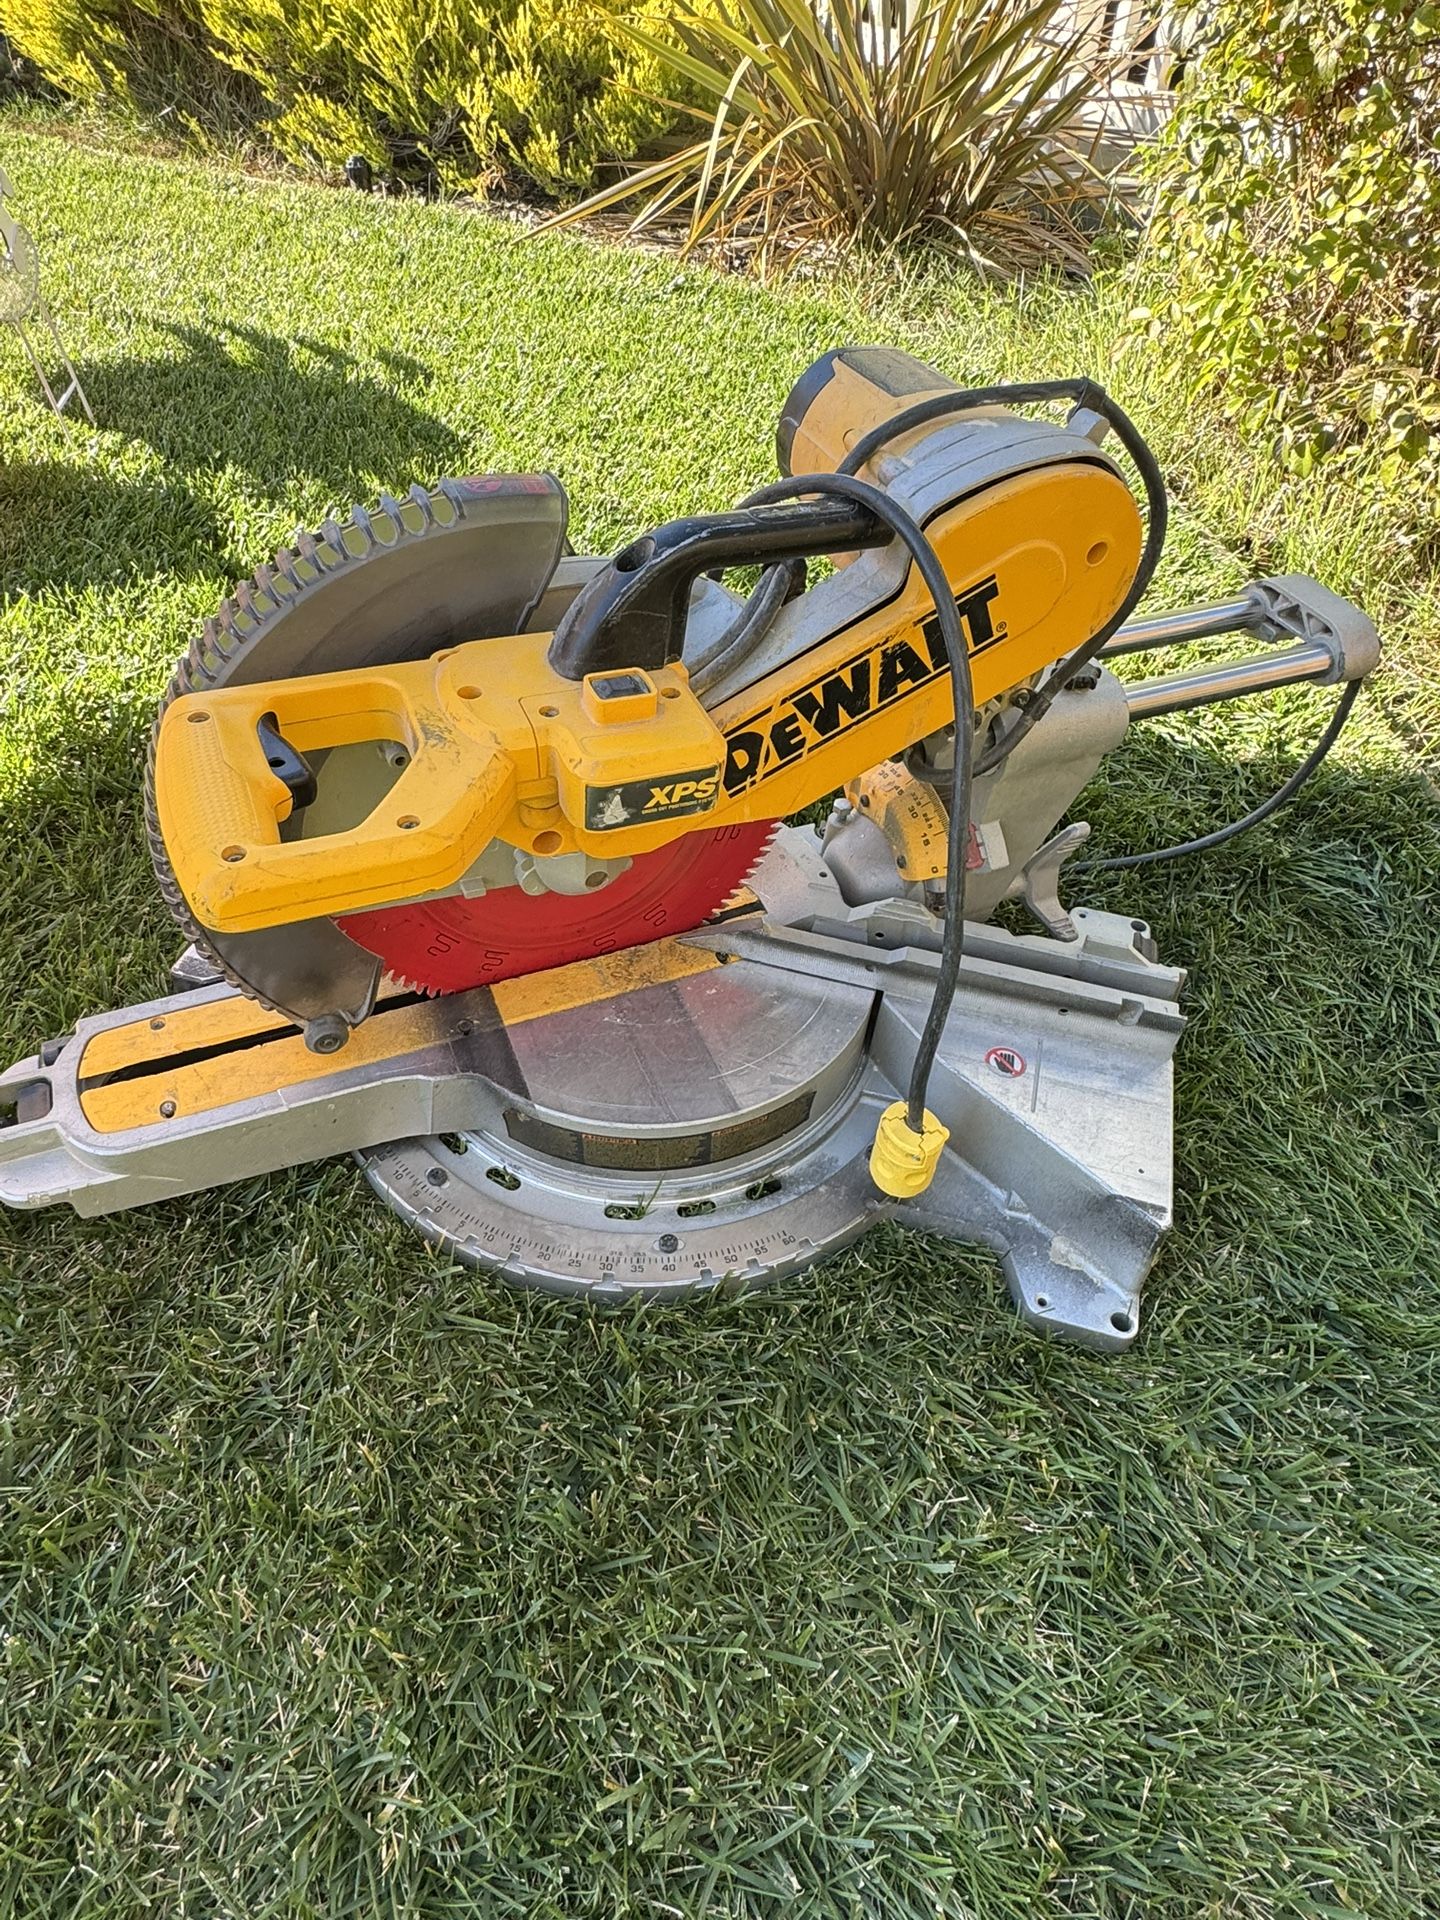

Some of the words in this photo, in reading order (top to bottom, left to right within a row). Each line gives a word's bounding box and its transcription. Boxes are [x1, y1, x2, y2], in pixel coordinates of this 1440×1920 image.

[643, 777, 719, 809] XPS
[893, 785, 905, 796] 45
[908, 805, 919, 819] 30
[921, 832, 931, 846] 15
[931, 866, 939, 874] 0
[393, 1169, 404, 1180] 10
[434, 1205, 443, 1213] 0
[458, 1220, 466, 1228] 5
[482, 1232, 495, 1242] 10
[509, 1243, 521, 1252] 15
[537, 1252, 551, 1261] 20
[567, 1259, 582, 1268] 25
[599, 1263, 613, 1271] 30
[630, 1265, 644, 1273] 35
[661, 1264, 676, 1272] 40
[693, 1260, 707, 1269] 45
[724, 1254, 738, 1264] 50
[754, 1246, 768, 1256] 55
[782, 1235, 796, 1246] 60
